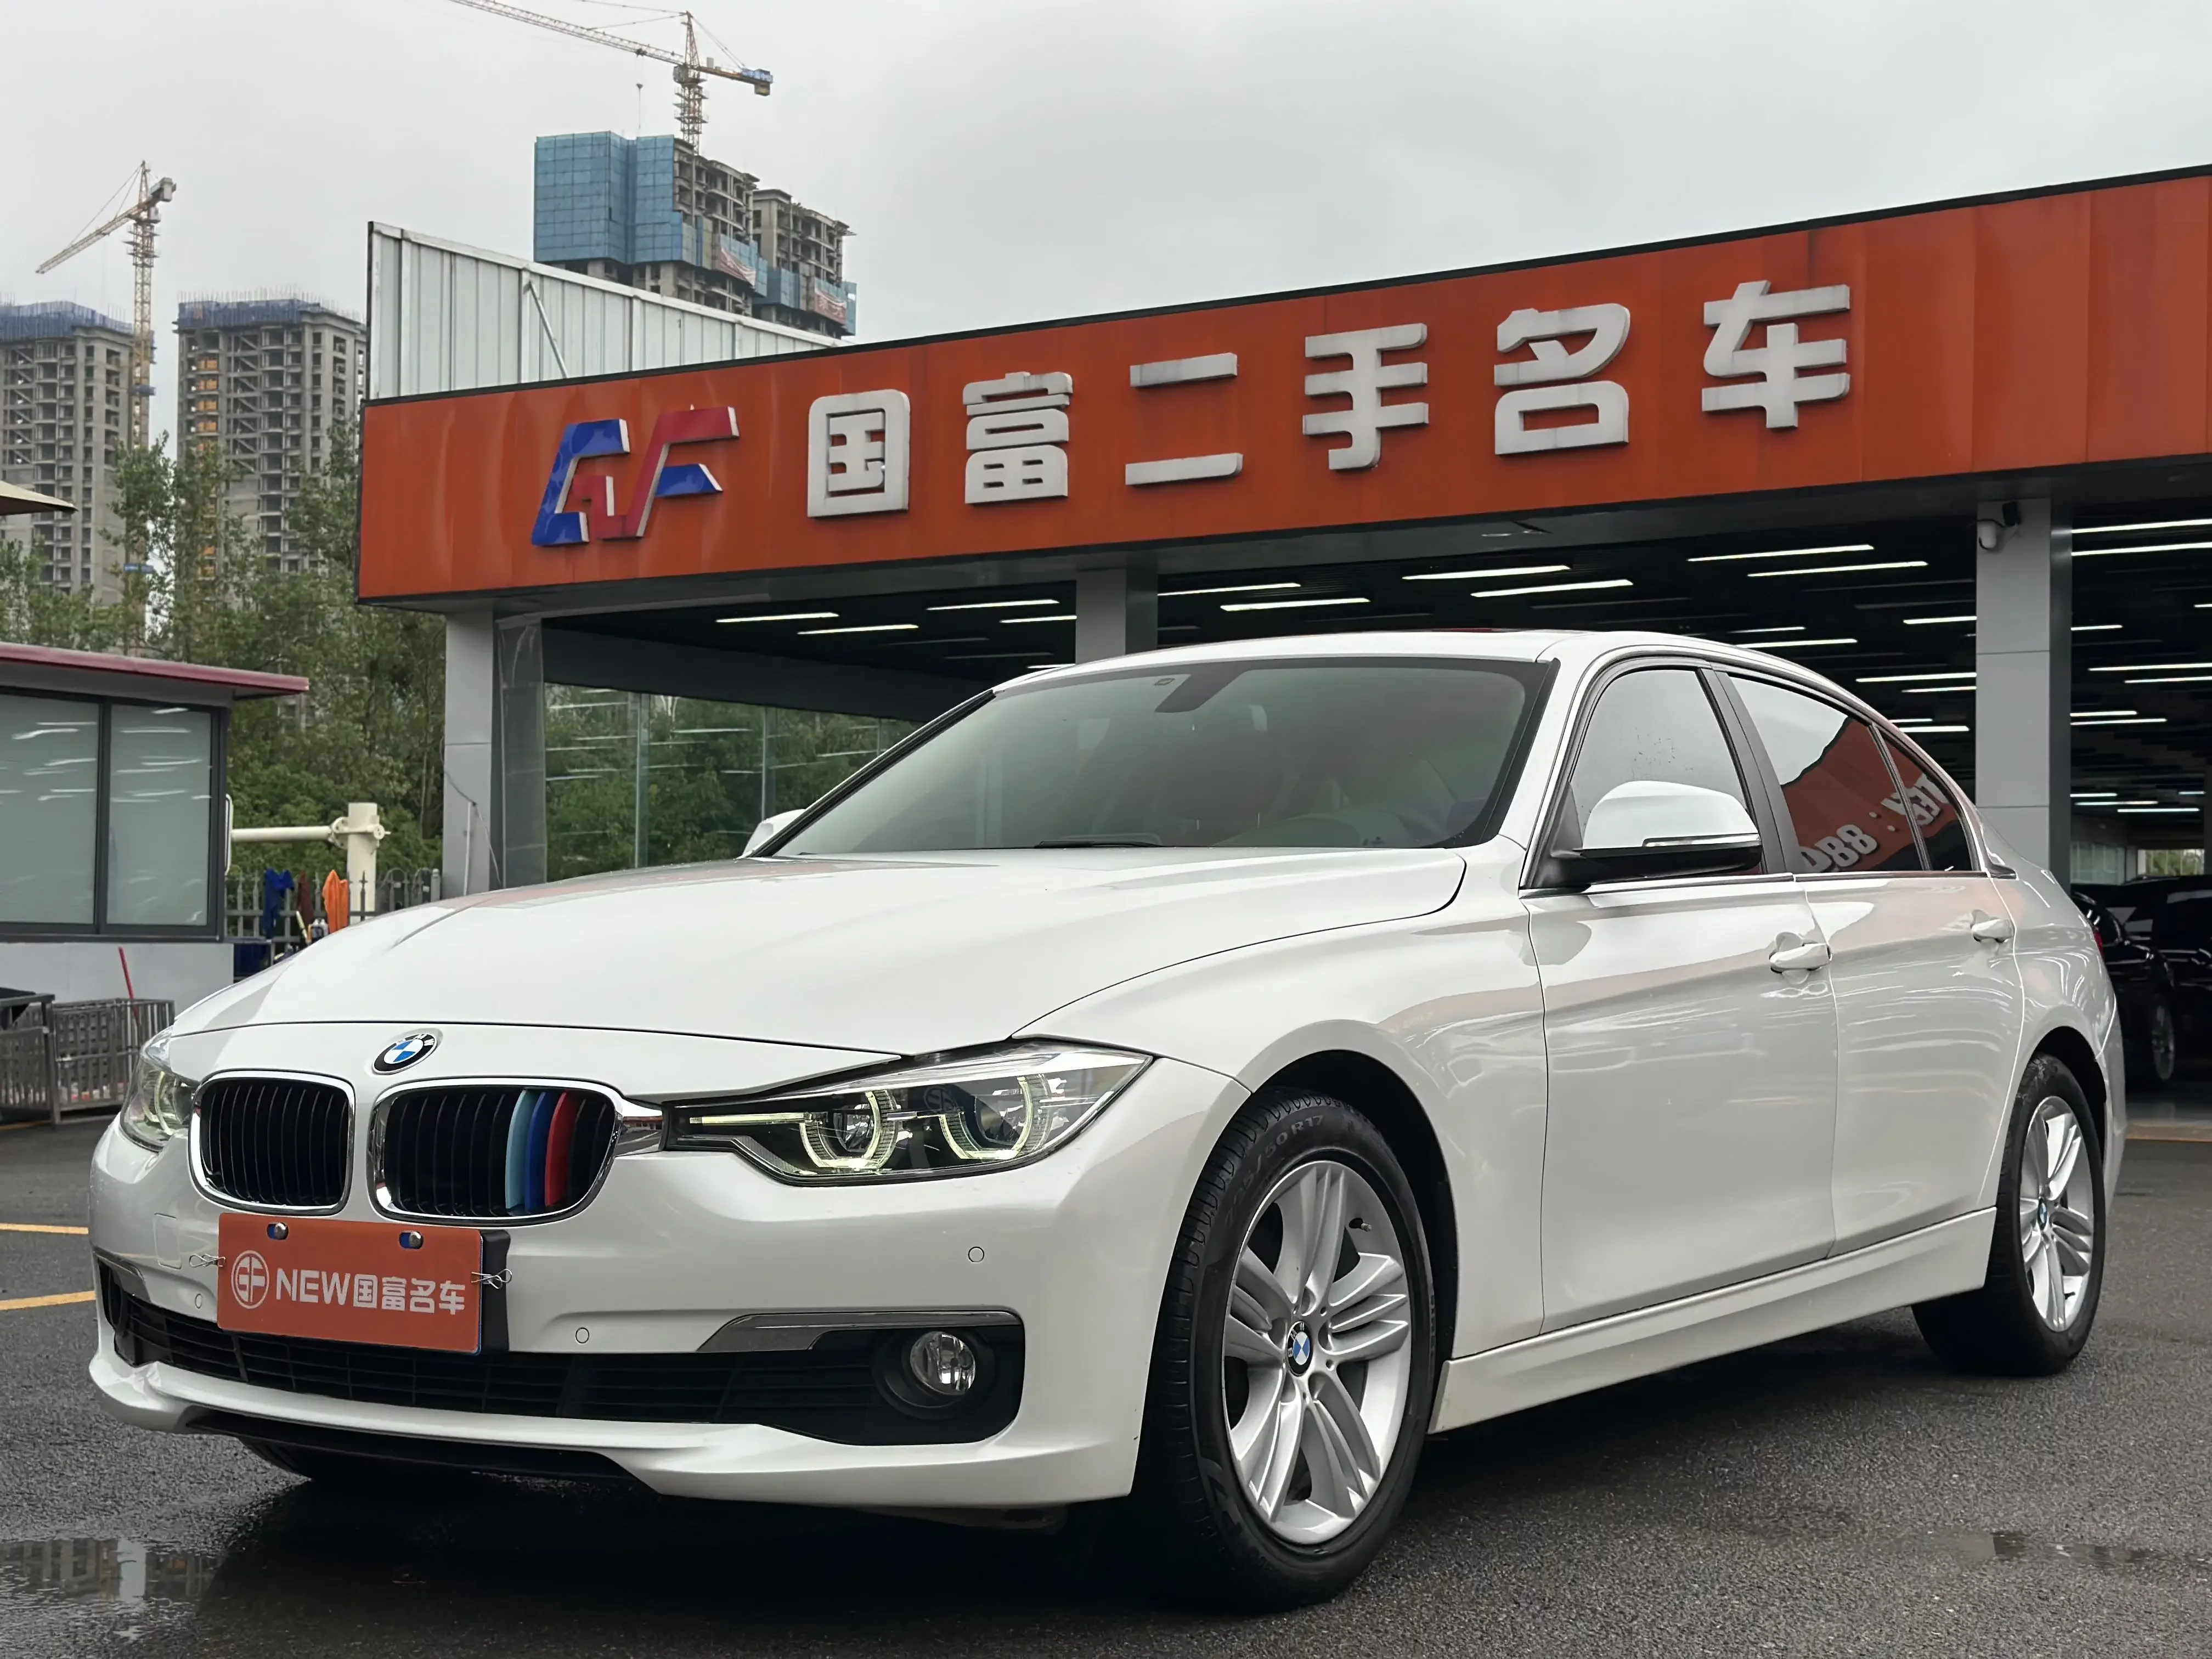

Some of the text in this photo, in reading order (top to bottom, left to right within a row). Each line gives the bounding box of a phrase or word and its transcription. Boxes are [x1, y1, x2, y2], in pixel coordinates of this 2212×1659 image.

[808, 279, 1851, 518] 国富二手名车
[276, 1267, 465, 1316] NEW国富名车
